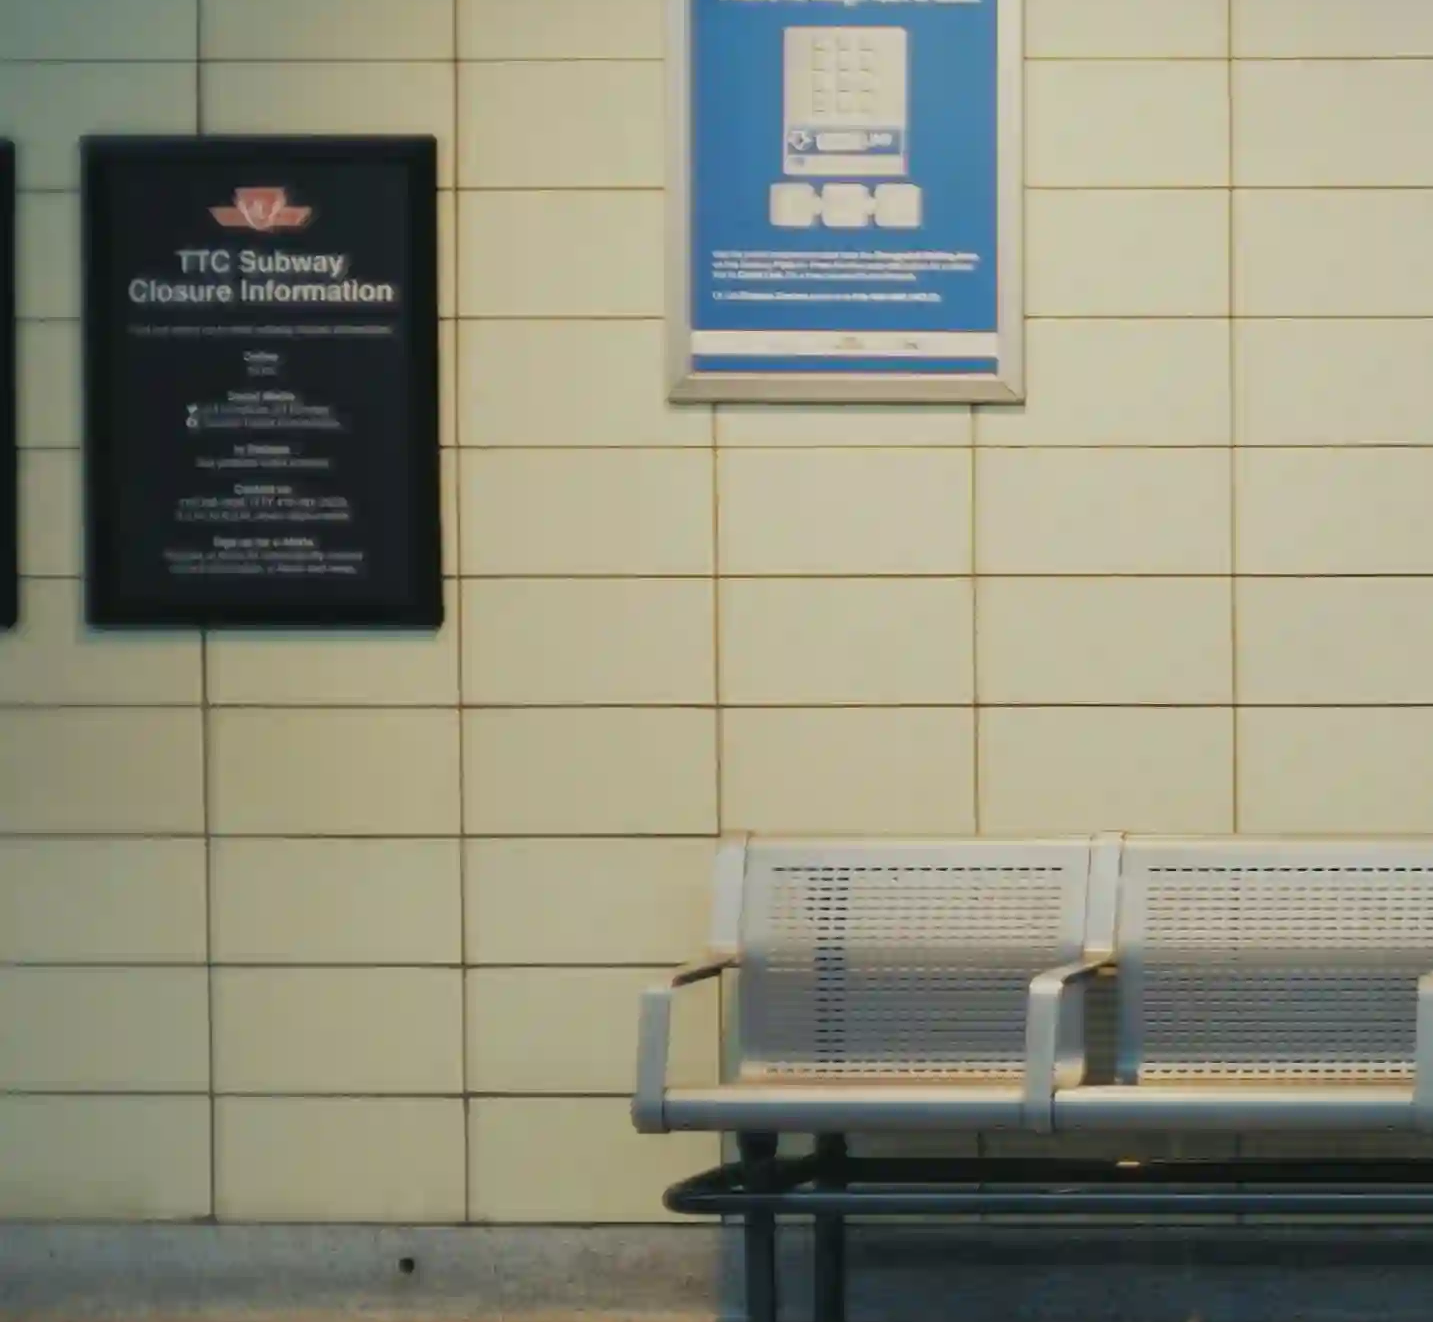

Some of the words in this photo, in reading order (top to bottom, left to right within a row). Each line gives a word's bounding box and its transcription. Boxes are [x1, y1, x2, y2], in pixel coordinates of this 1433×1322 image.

[176, 249, 231, 274] TTC
[238, 249, 345, 281] Subway
[127, 279, 232, 303] Closure
[240, 279, 394, 303] Information
